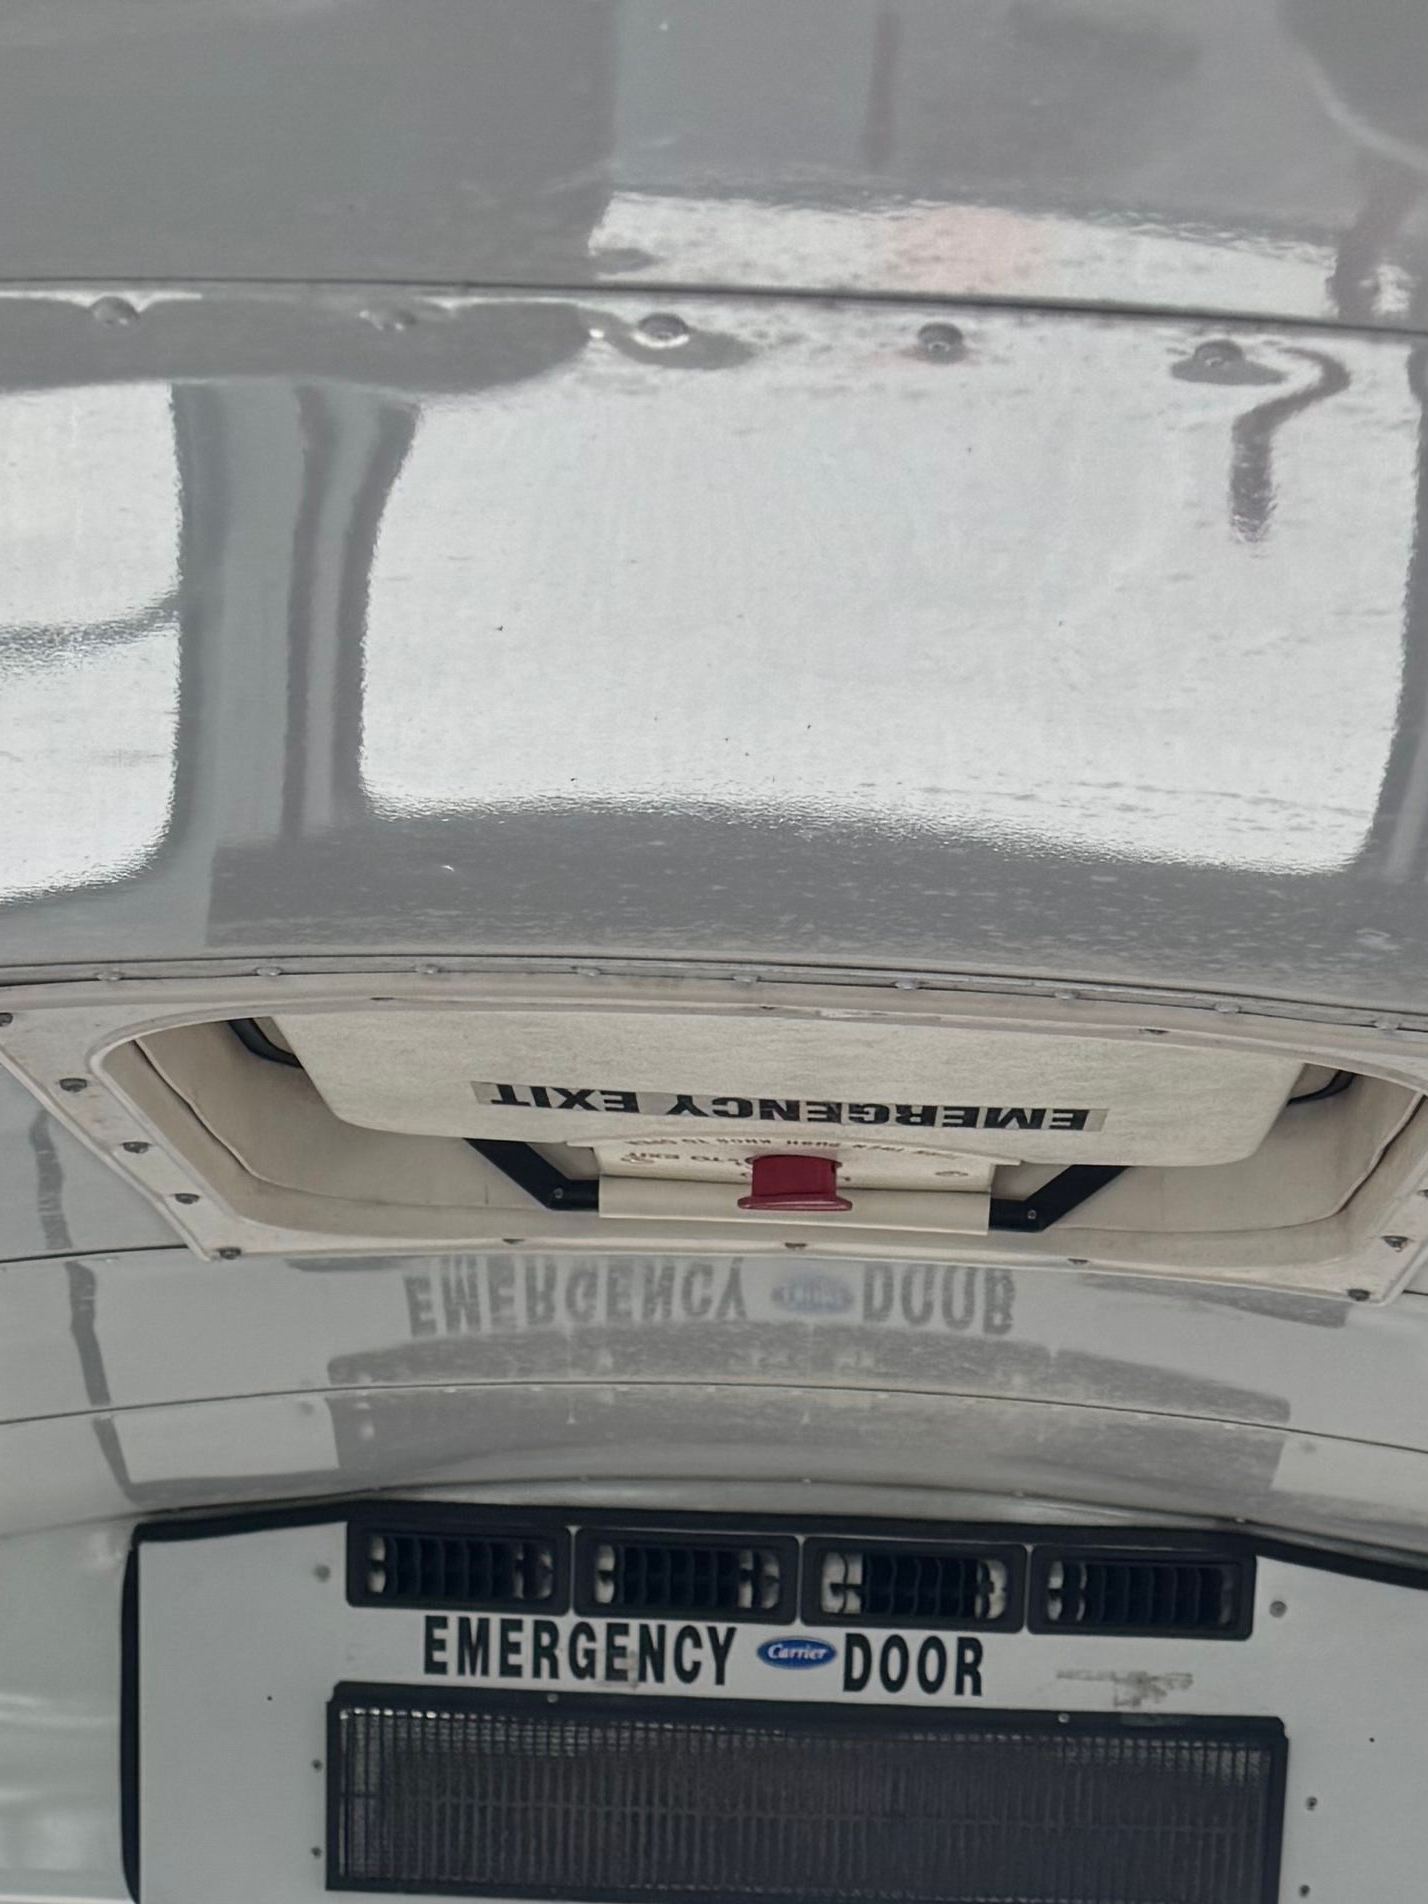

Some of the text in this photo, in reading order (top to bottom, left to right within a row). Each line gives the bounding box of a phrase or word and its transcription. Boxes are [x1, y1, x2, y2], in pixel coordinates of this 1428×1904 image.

[491, 1083, 1090, 1131] EMERGENCY EXIT
[424, 1614, 737, 1687] EMERGENCY
[842, 1632, 984, 1697] DOOR
[767, 1643, 829, 1660] Carrier
